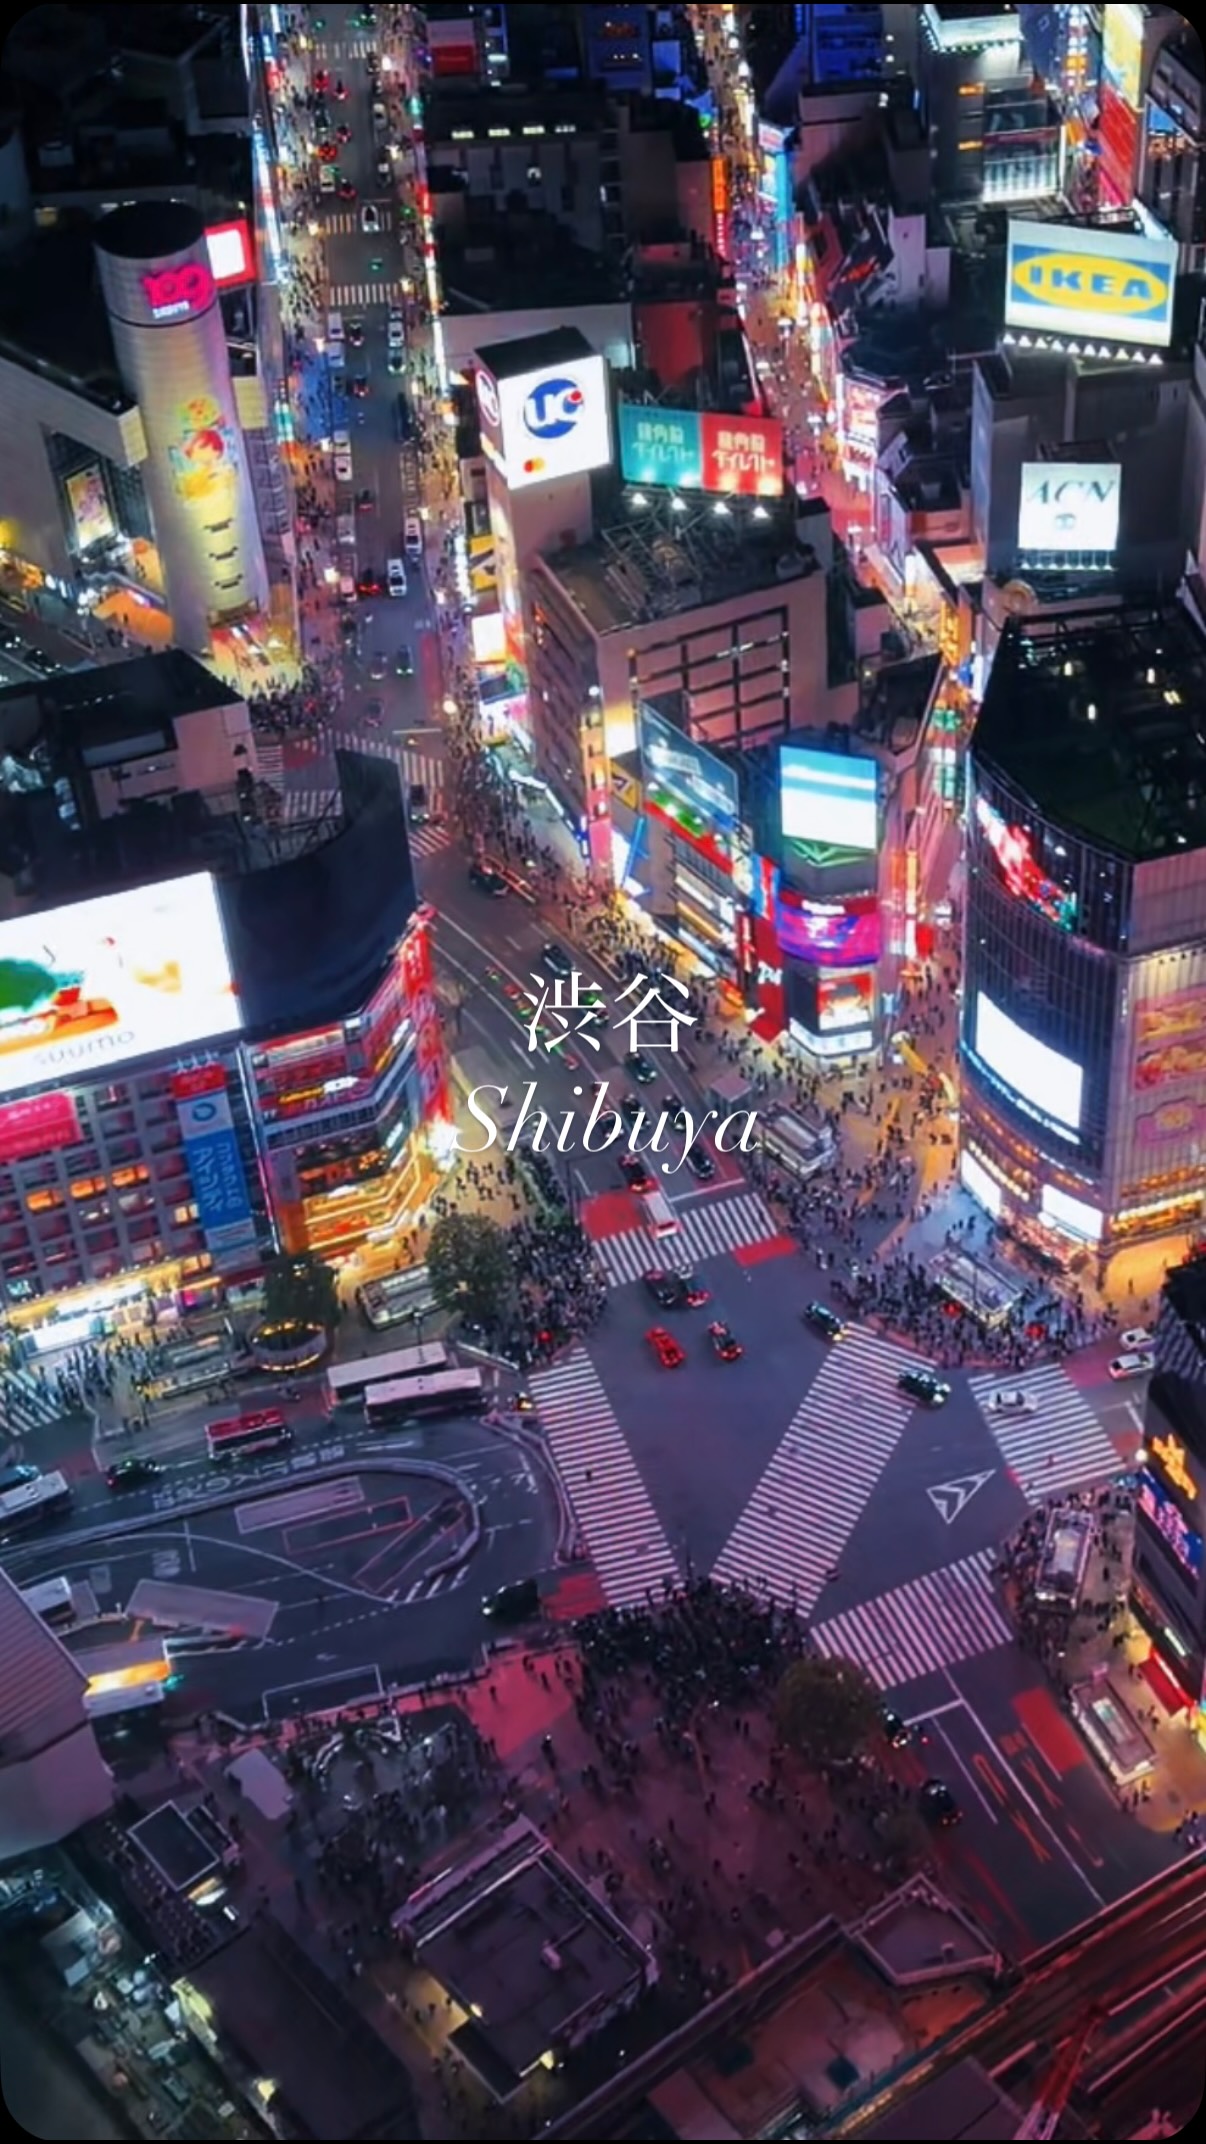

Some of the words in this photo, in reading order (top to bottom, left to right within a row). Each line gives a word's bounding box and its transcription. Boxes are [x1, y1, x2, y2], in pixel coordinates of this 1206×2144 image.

[143, 264, 215, 311] 109
[1029, 265, 1152, 302] IKEA
[1027, 480, 1116, 504] ACN
